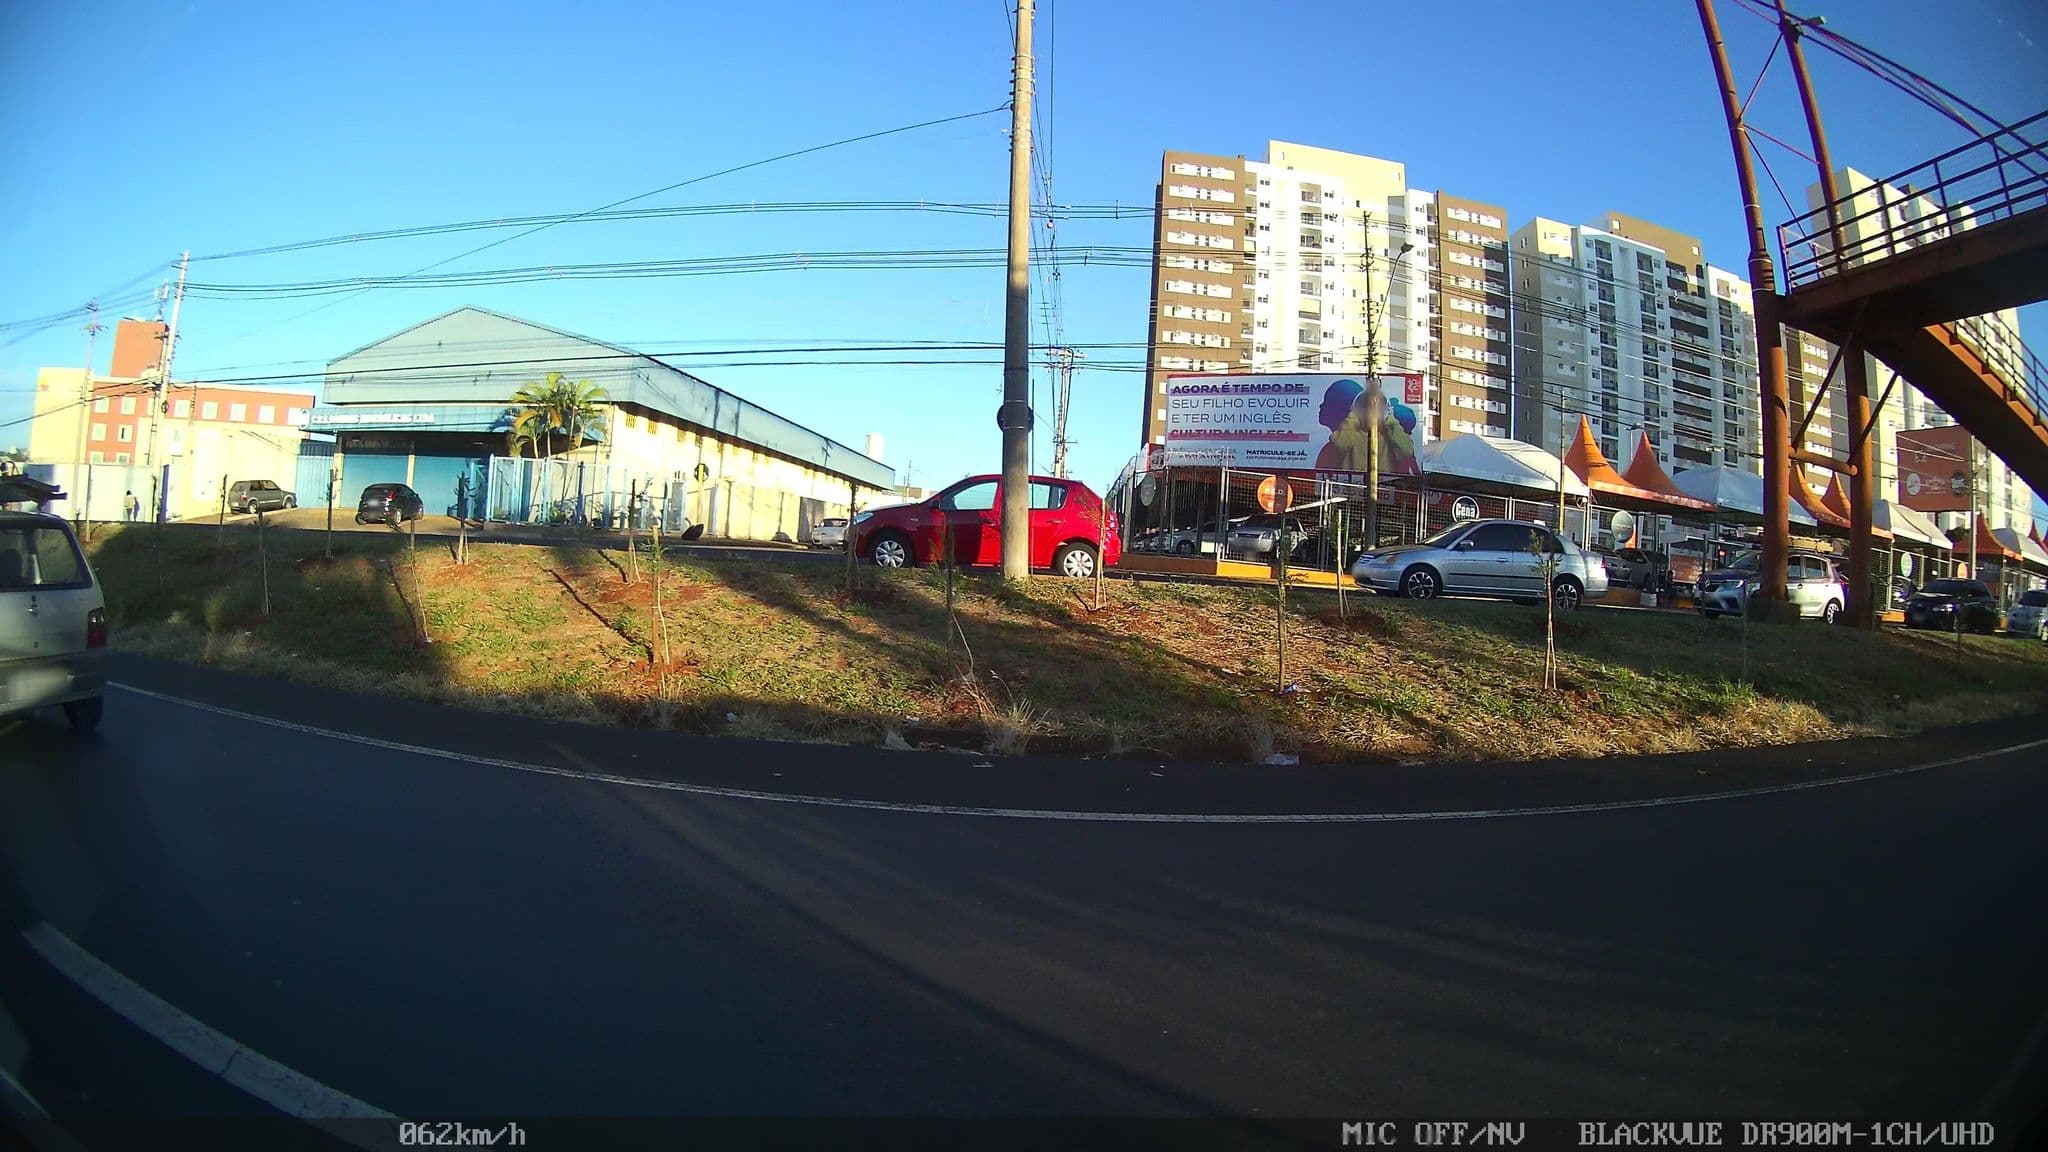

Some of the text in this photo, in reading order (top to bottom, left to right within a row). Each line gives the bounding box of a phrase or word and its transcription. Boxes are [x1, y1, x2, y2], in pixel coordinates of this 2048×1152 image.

[1172, 381, 1304, 394] AGORA É TEMPO DE
[1172, 398, 1310, 409] SEU FILHO EVOLUIR
[1171, 411, 1291, 424] E TER UM INGLÊS
[1170, 429, 1295, 439] CULTURA INGLESA
